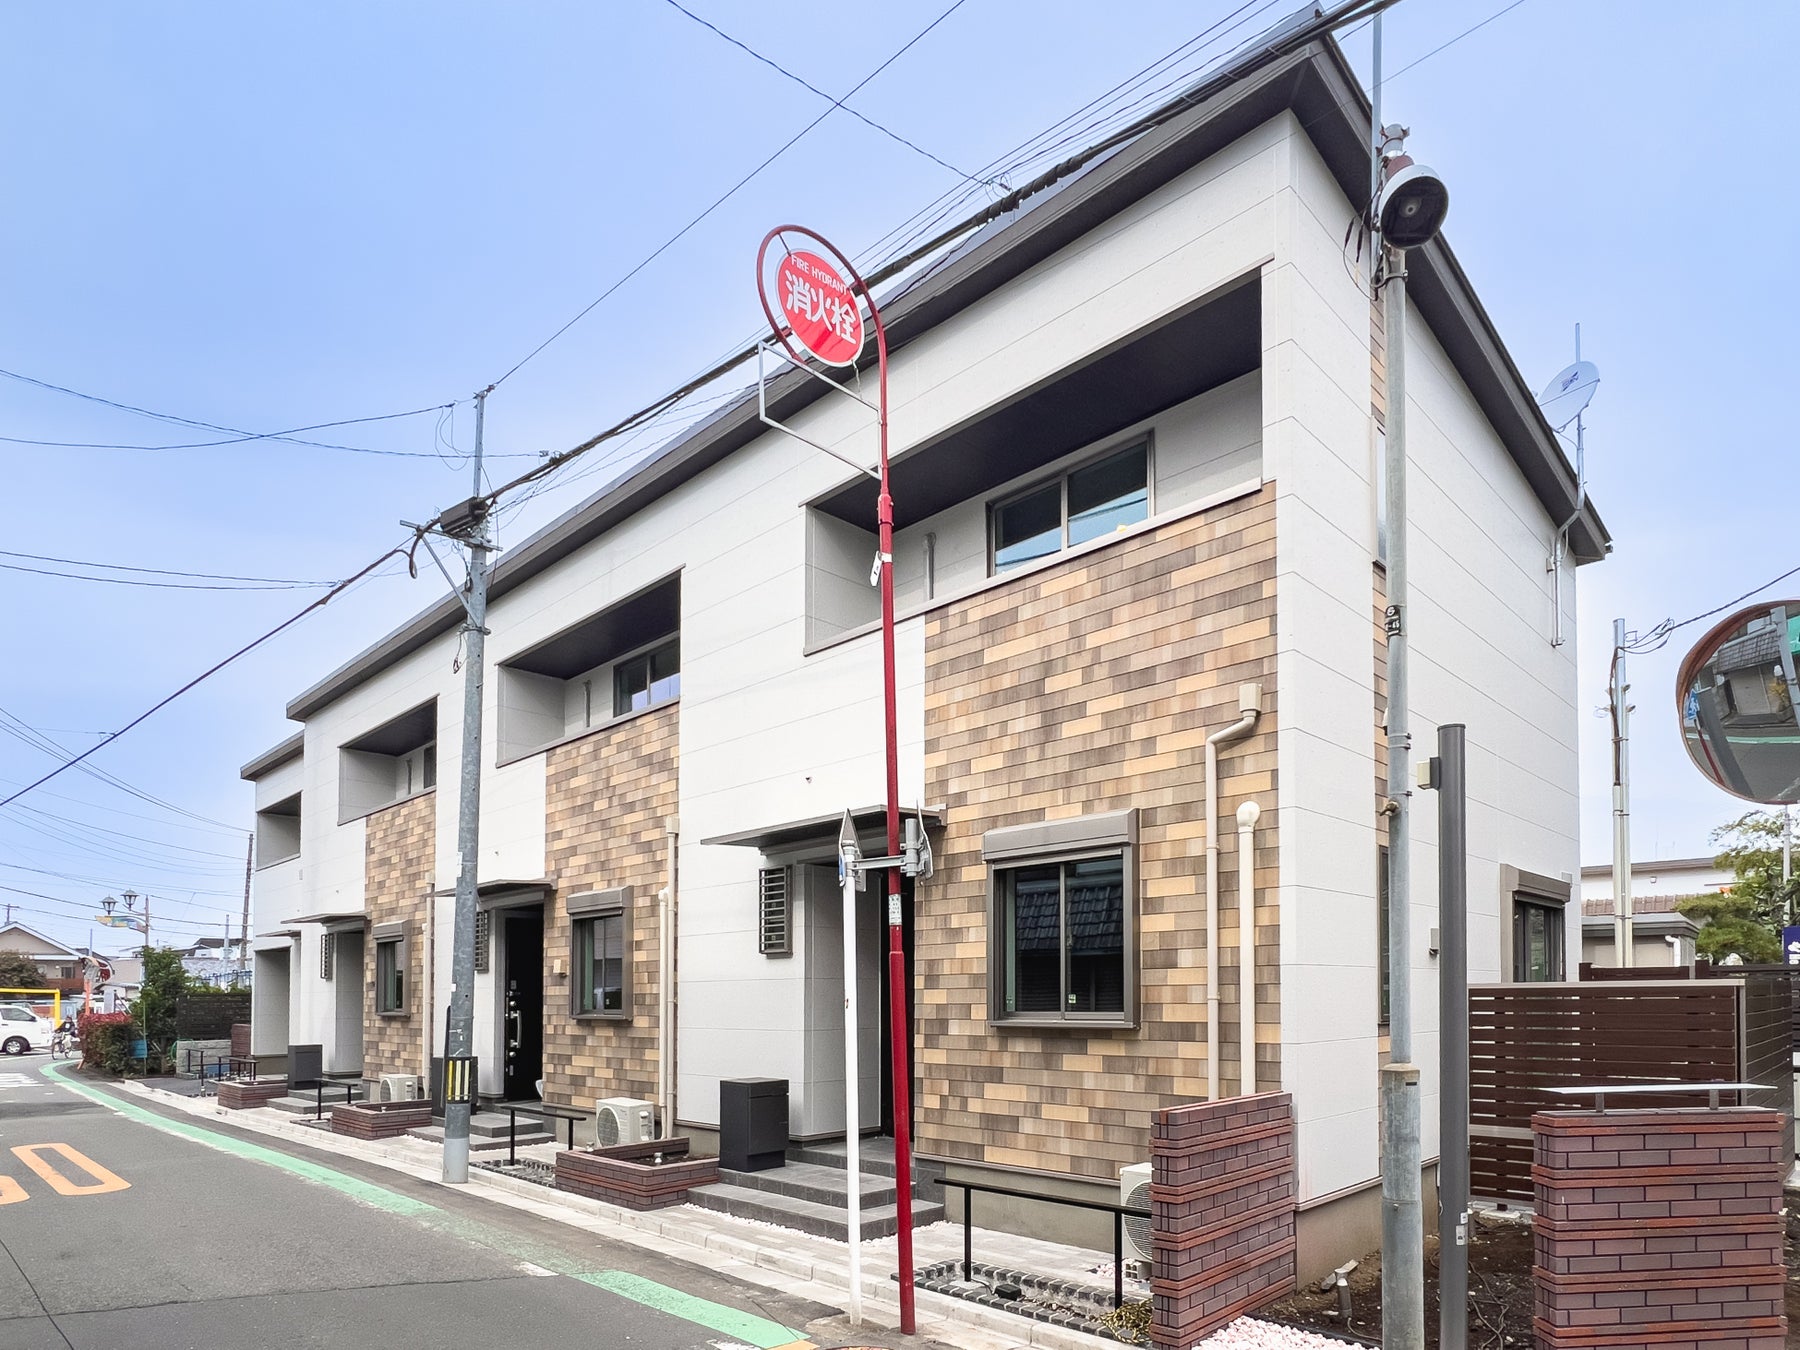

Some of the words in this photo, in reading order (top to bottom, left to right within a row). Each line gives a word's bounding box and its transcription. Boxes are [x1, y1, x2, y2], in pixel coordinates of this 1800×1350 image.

[791, 255, 809, 274] FIRE
[811, 266, 848, 296] HYDRANT
[784, 269, 857, 344] 消火栓
